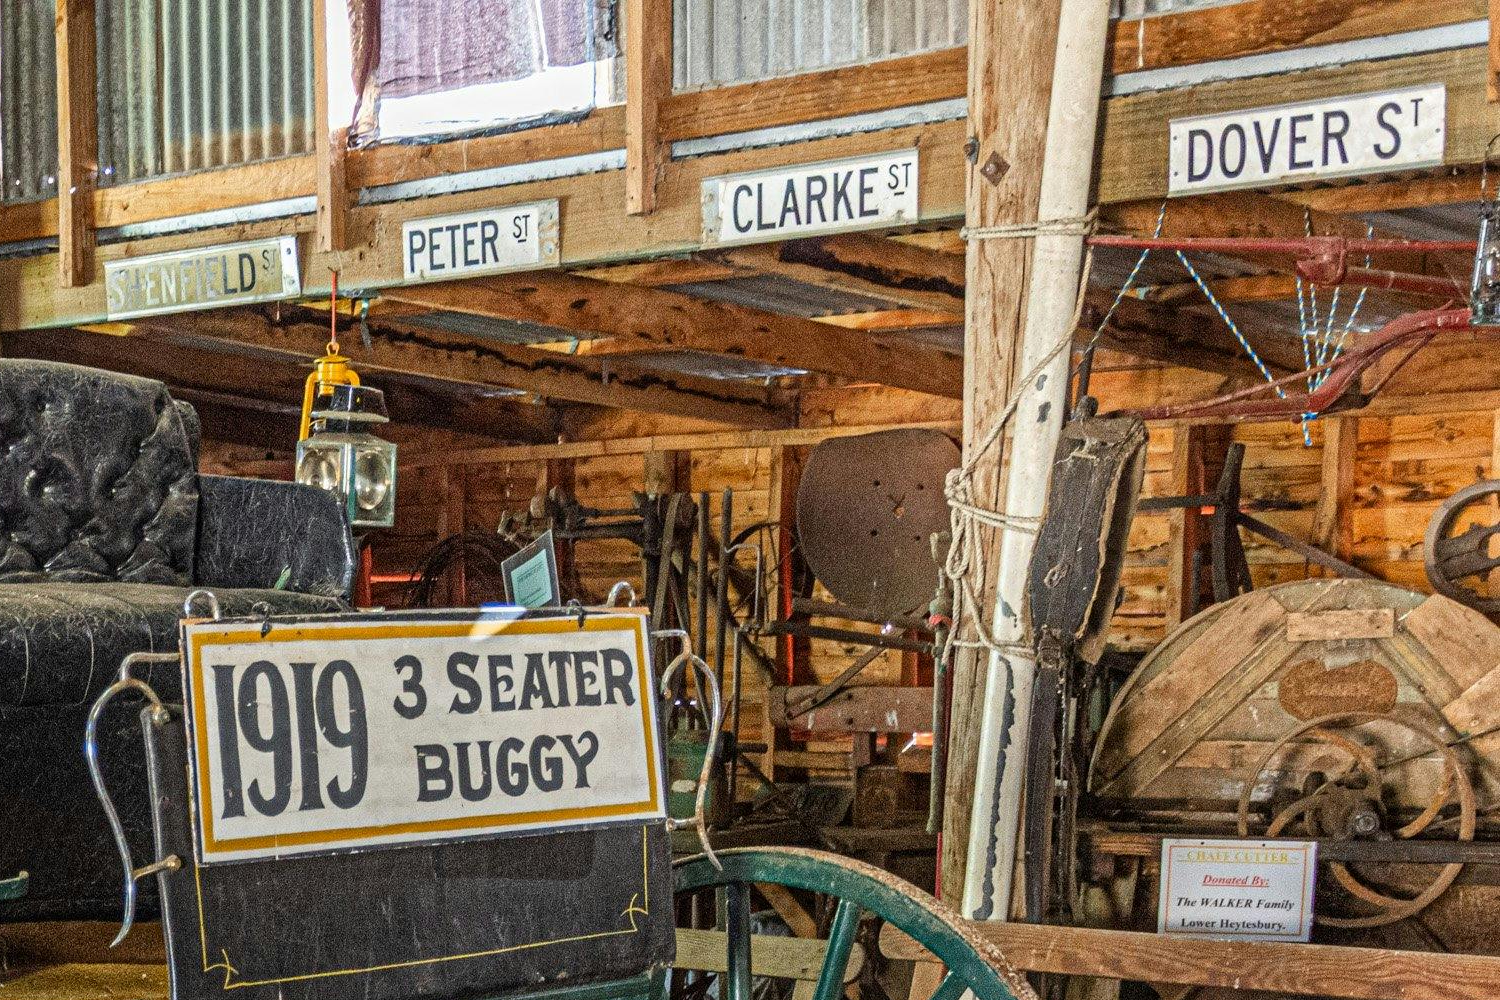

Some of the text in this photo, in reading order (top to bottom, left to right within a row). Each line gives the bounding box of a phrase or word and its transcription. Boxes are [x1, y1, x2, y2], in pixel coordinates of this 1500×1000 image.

[1187, 97, 1424, 183] DOVER ST
[732, 162, 912, 234] CLARKE ST
[408, 214, 531, 274] PETER ST
[393, 648, 636, 719] 3 SEATER
[211, 659, 369, 820] 1919
[414, 730, 599, 802] BUGGY
[1177, 897, 1295, 911] The WALKER Family
[1203, 874, 1269, 887] Donated By:
[1181, 918, 1286, 932] Lower Heytesbury.
